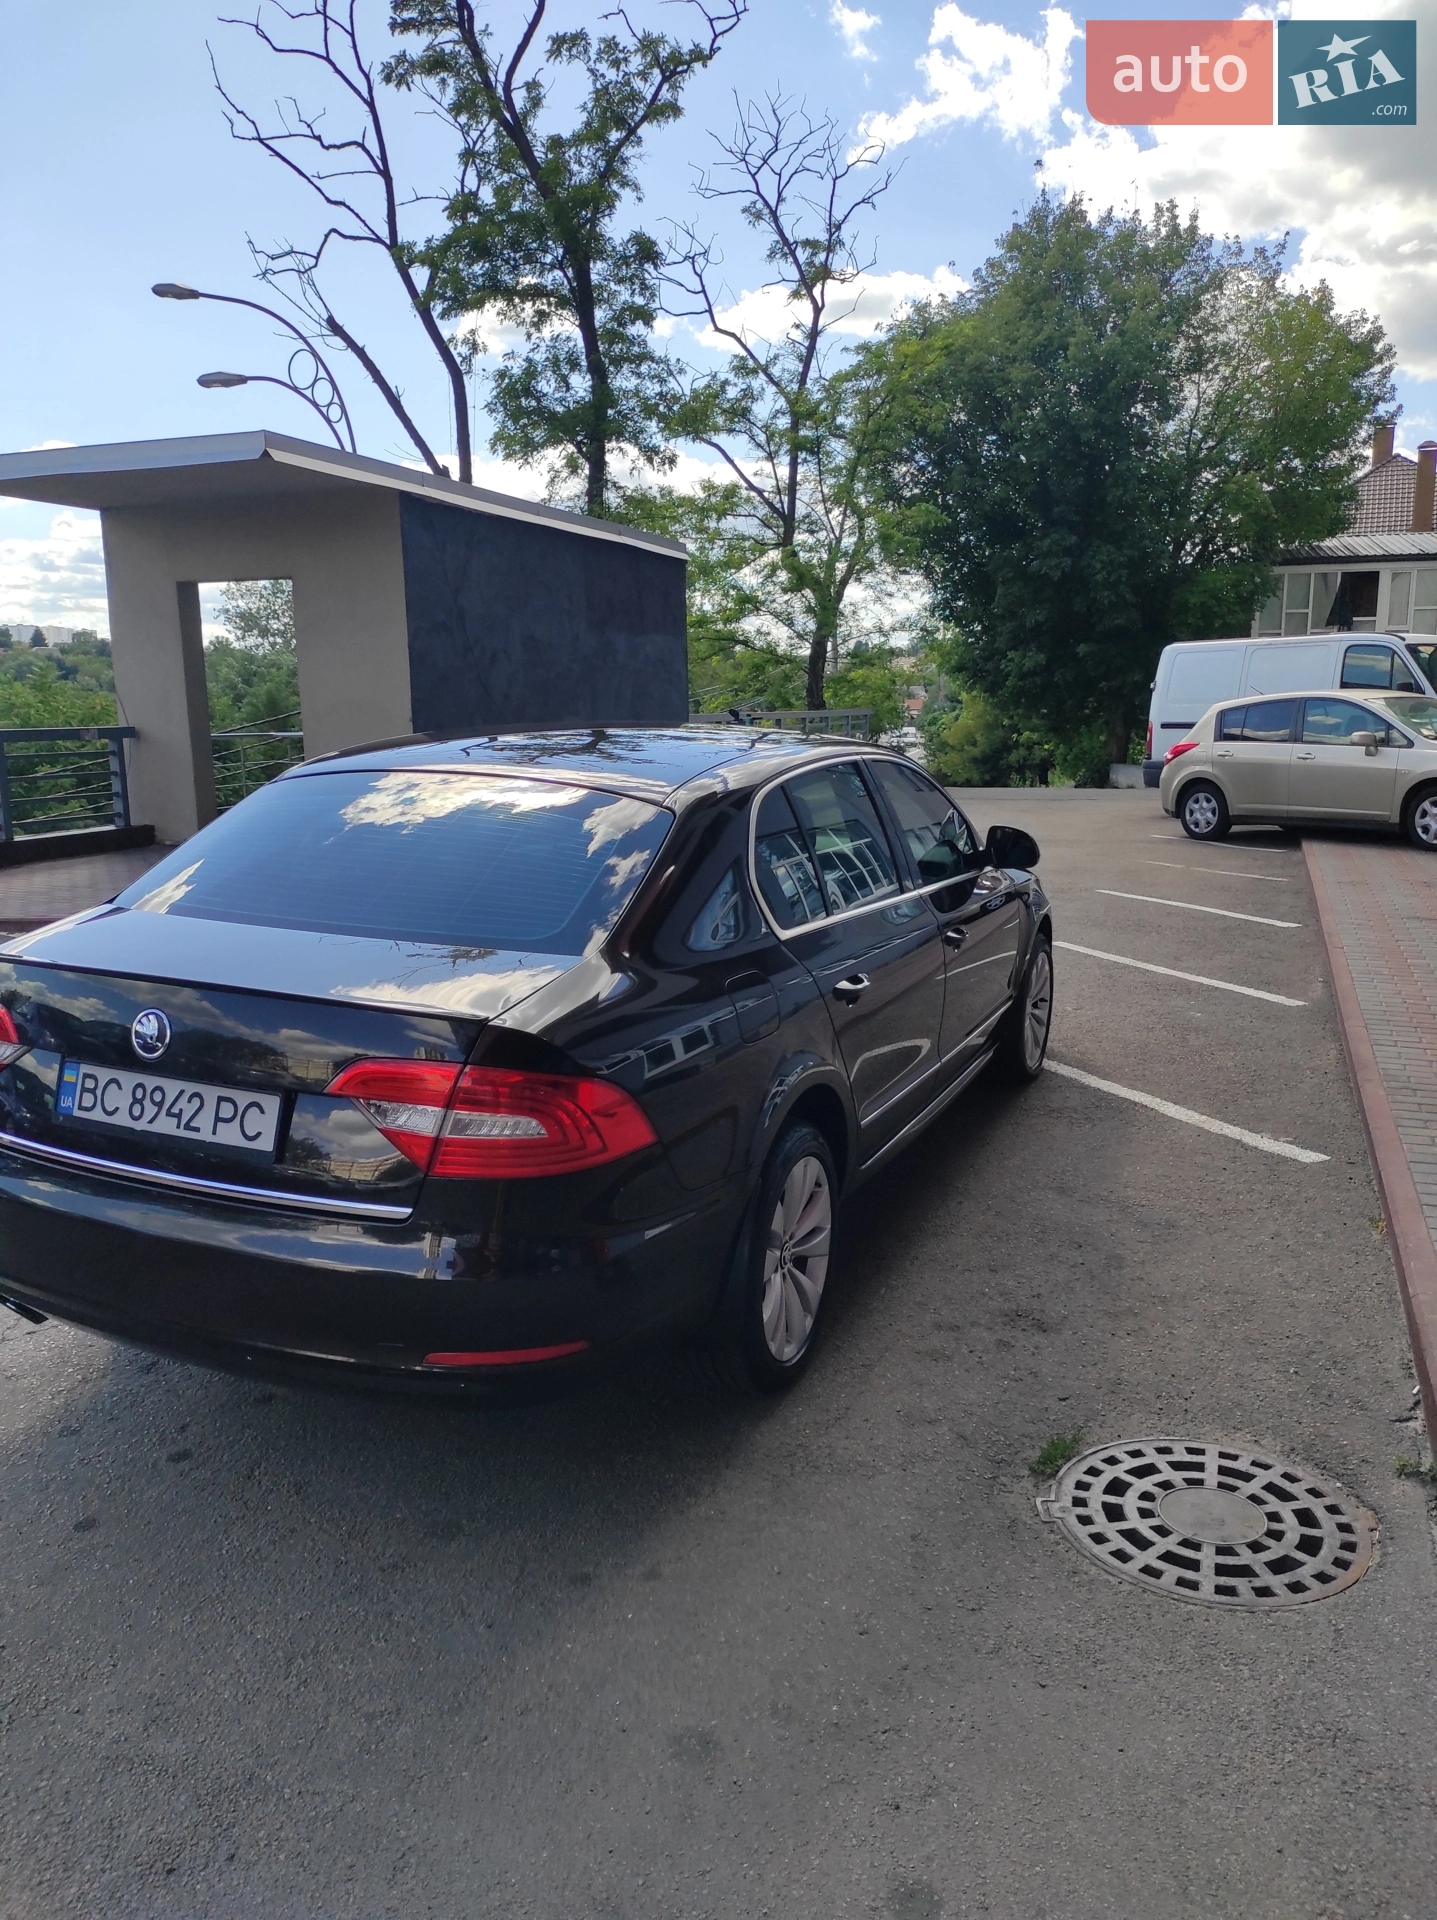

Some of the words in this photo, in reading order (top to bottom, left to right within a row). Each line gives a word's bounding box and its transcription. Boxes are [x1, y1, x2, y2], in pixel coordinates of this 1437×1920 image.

[60, 1095, 73, 1109] UA
[77, 1072, 123, 1117] BC
[128, 1082, 205, 1133] 8942
[211, 1095, 265, 1142] PC
